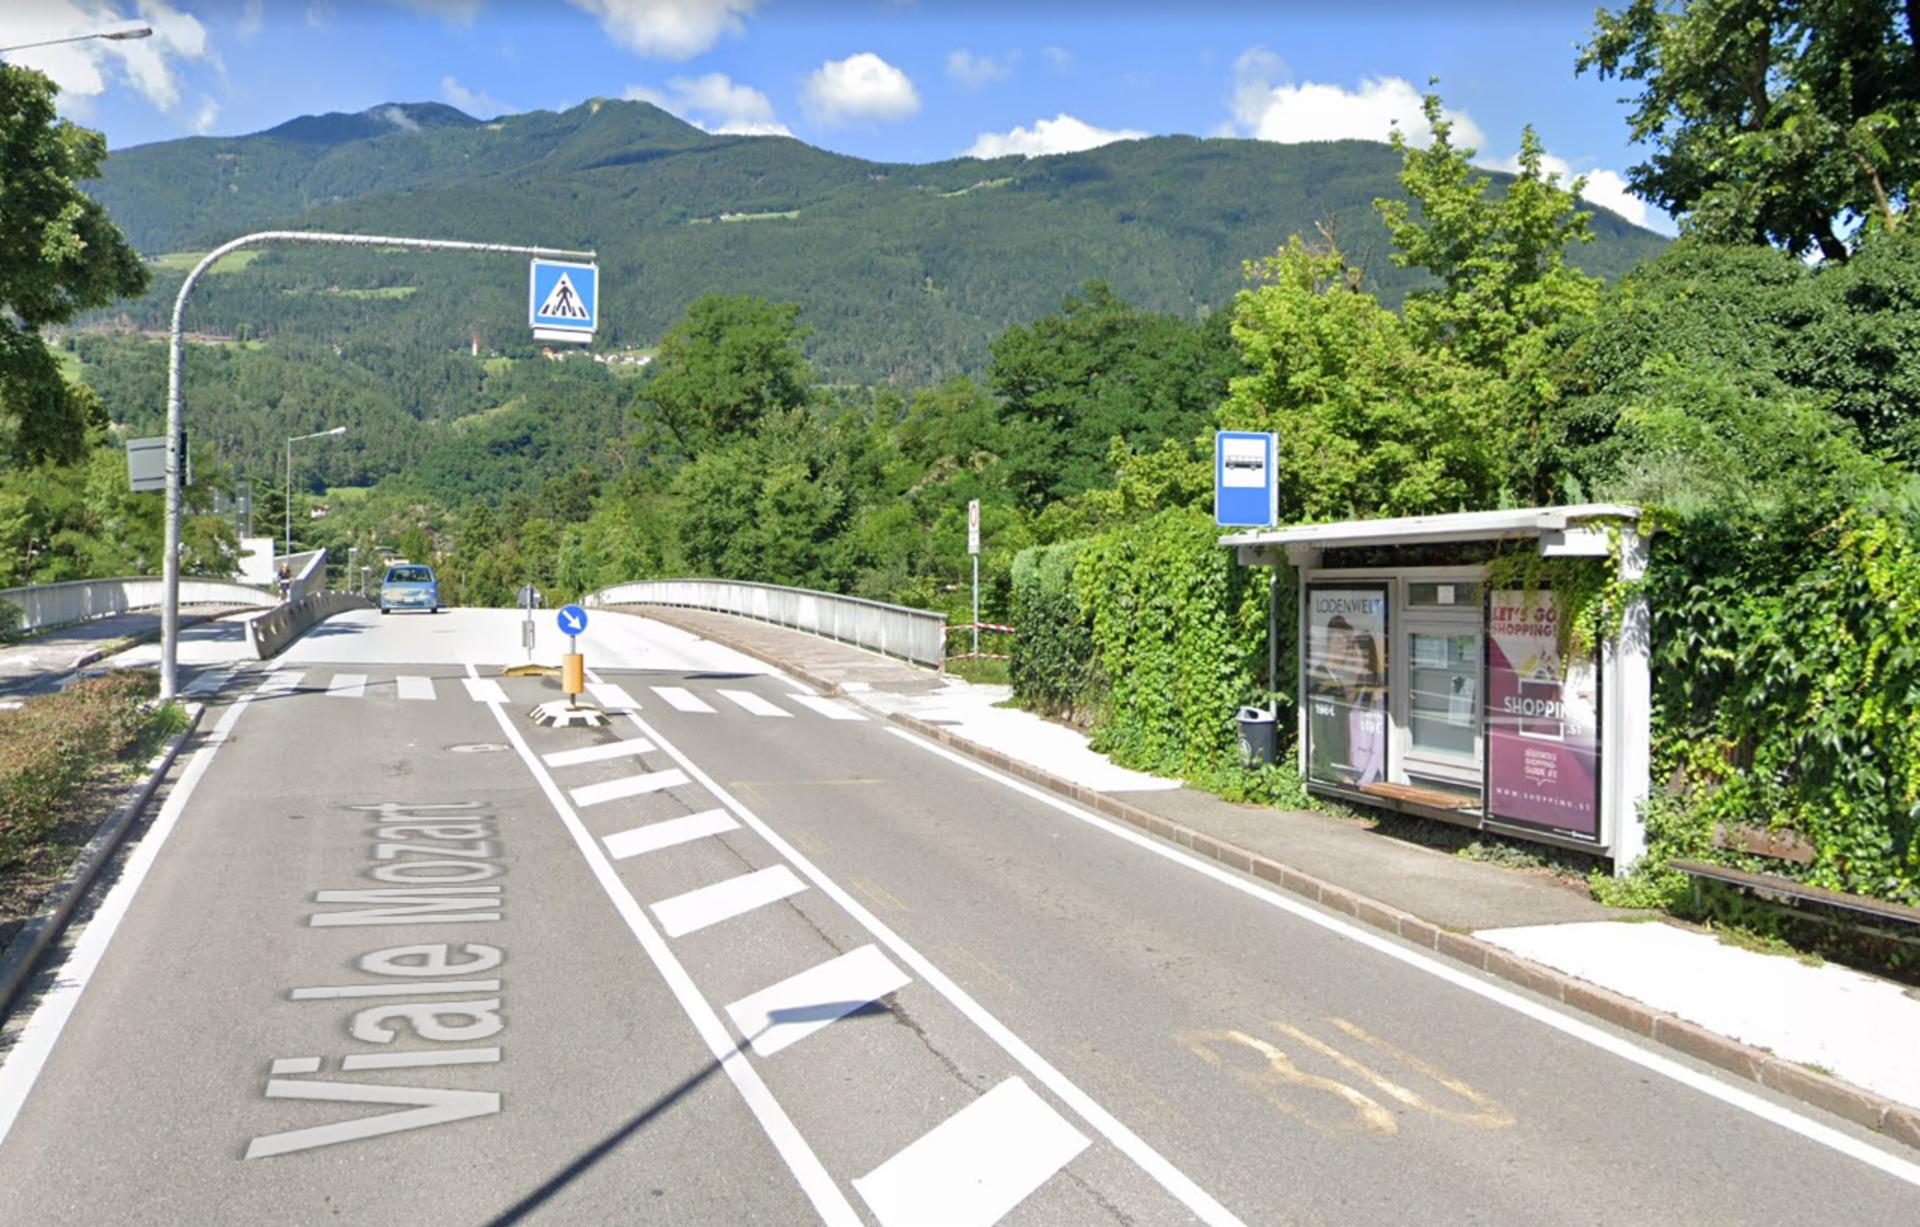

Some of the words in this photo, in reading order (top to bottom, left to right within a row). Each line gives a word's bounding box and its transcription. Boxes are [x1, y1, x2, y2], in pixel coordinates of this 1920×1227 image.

[1315, 597, 1382, 615] LODENWELT
[1492, 606, 1527, 622] LET'S
[1534, 606, 1557, 623] GO
[1492, 622, 1558, 638] SHOPPING!
[1503, 694, 1577, 721] SHOPPIN
